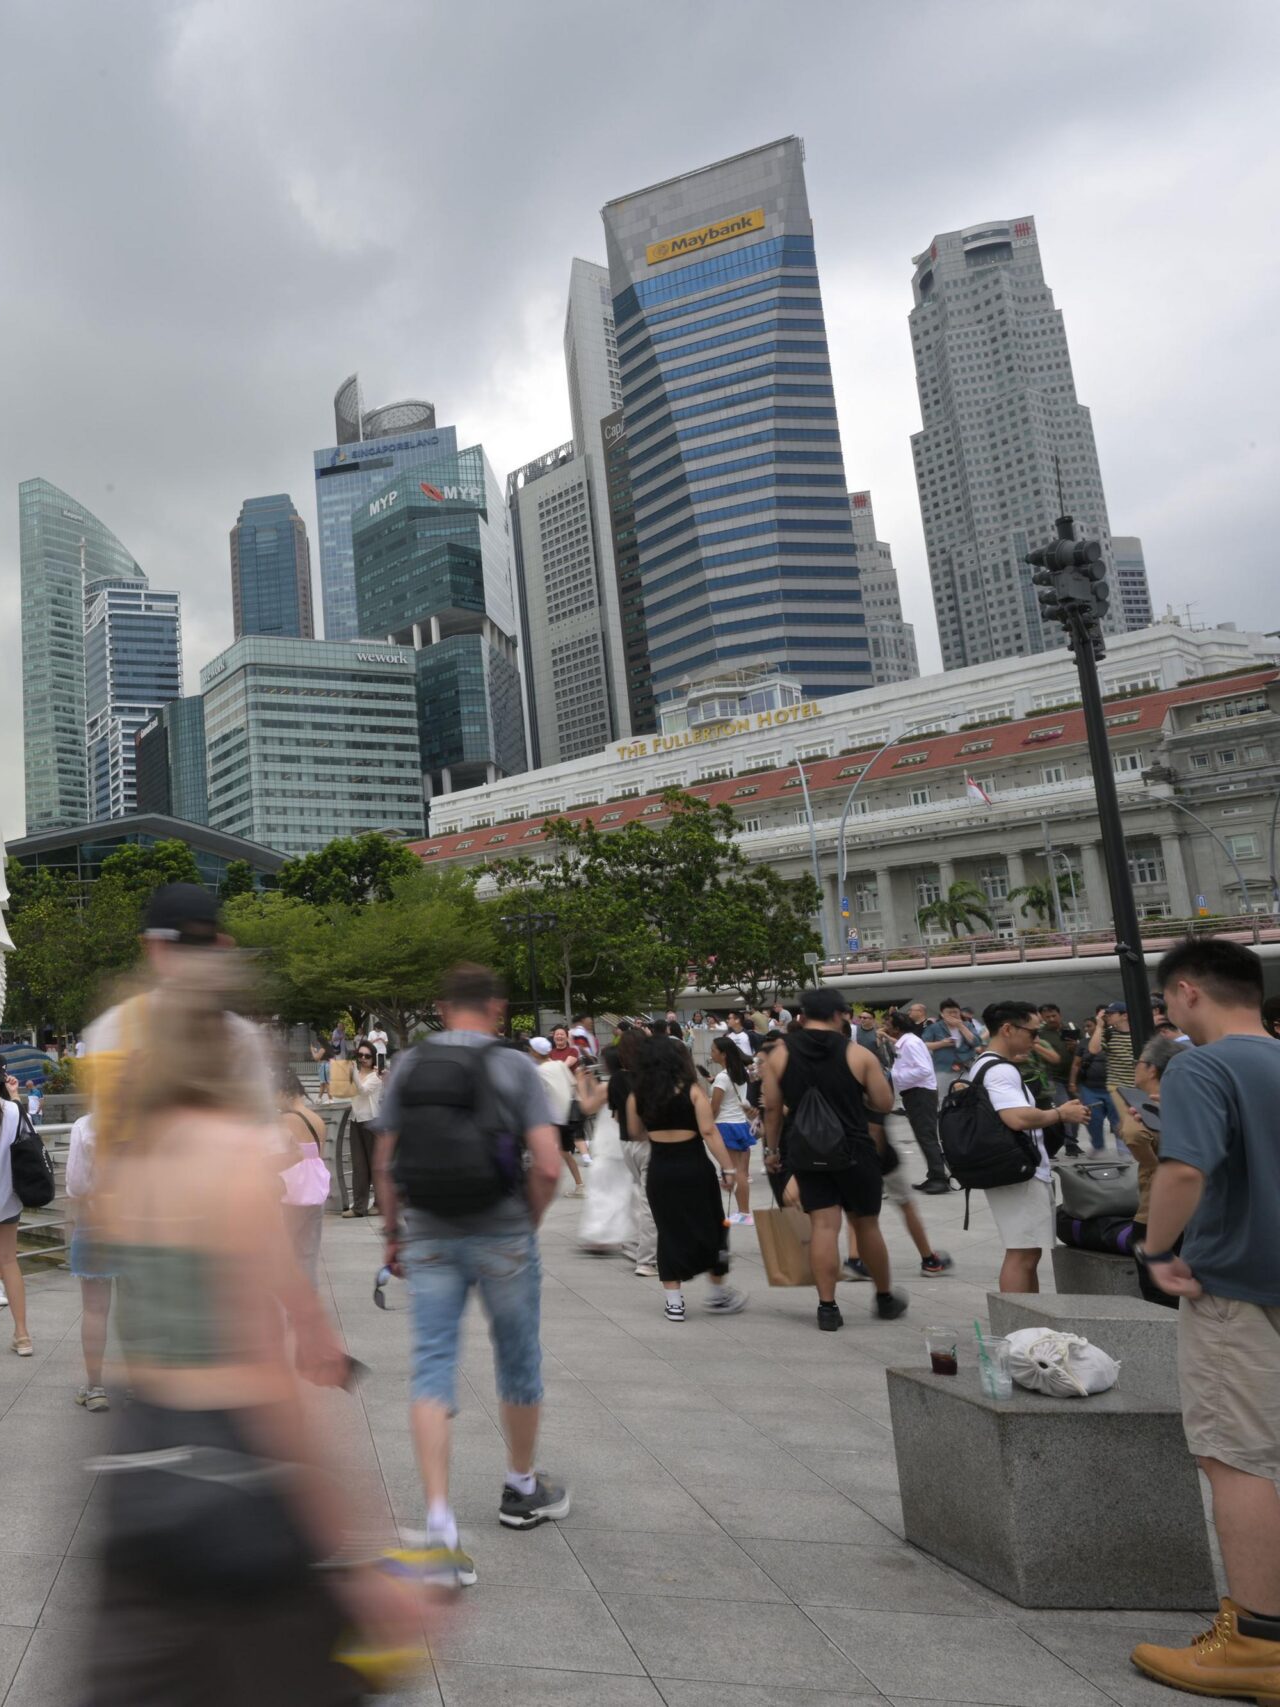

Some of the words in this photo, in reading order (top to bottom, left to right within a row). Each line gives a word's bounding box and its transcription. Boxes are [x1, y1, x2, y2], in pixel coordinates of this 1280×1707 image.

[671, 216, 753, 252] Maybank
[370, 490, 398, 517] MYP
[443, 486, 481, 500] MYP
[356, 651, 409, 665] wework
[617, 742, 647, 760] THE
[652, 718, 750, 753] FULLERTON
[757, 702, 823, 729] HOTEL
